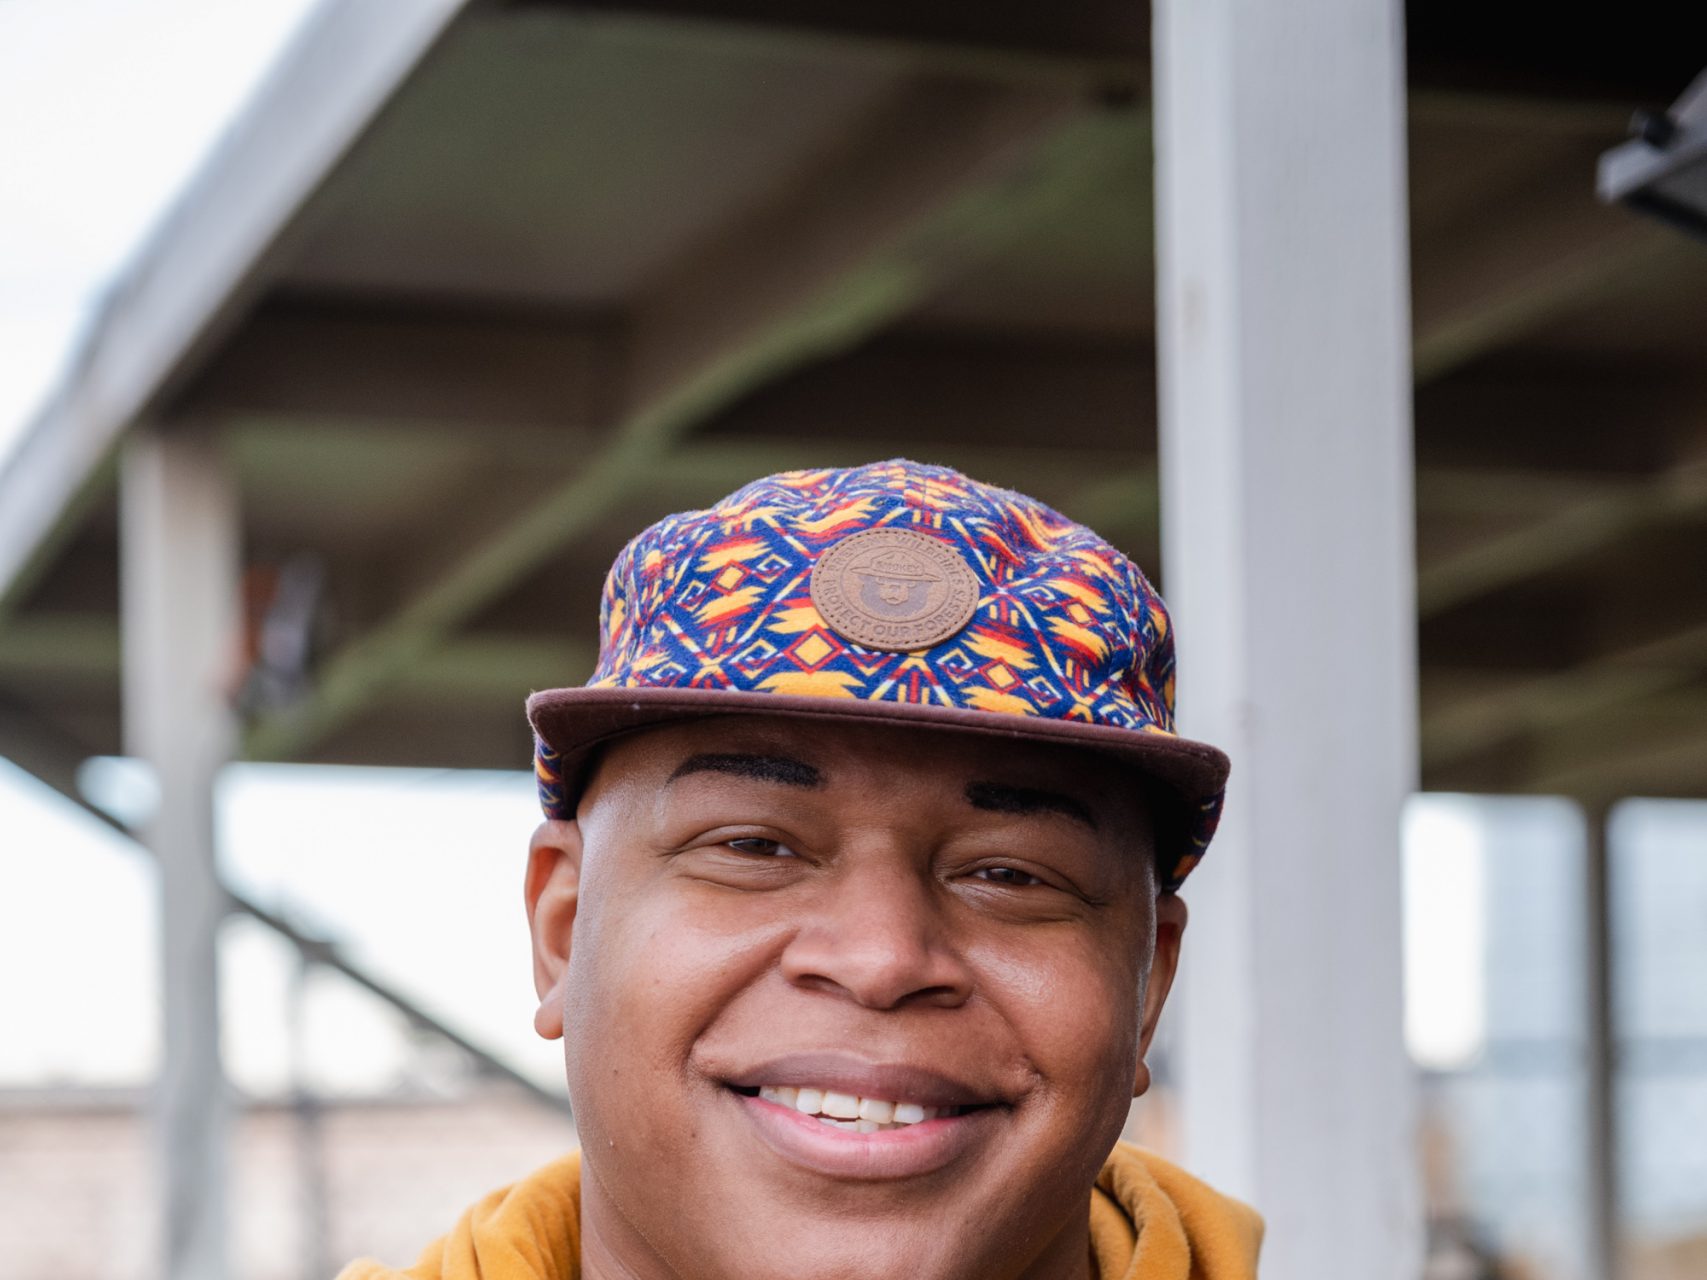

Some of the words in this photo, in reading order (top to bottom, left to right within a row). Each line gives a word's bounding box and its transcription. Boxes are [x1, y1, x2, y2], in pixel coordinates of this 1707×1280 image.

[826, 535, 889, 572] PREVENT
[876, 560, 920, 574] SMOKEY
[822, 578, 872, 631] PROTECT
[875, 624, 911, 637] OUR
[913, 589, 967, 634] FORESTS
